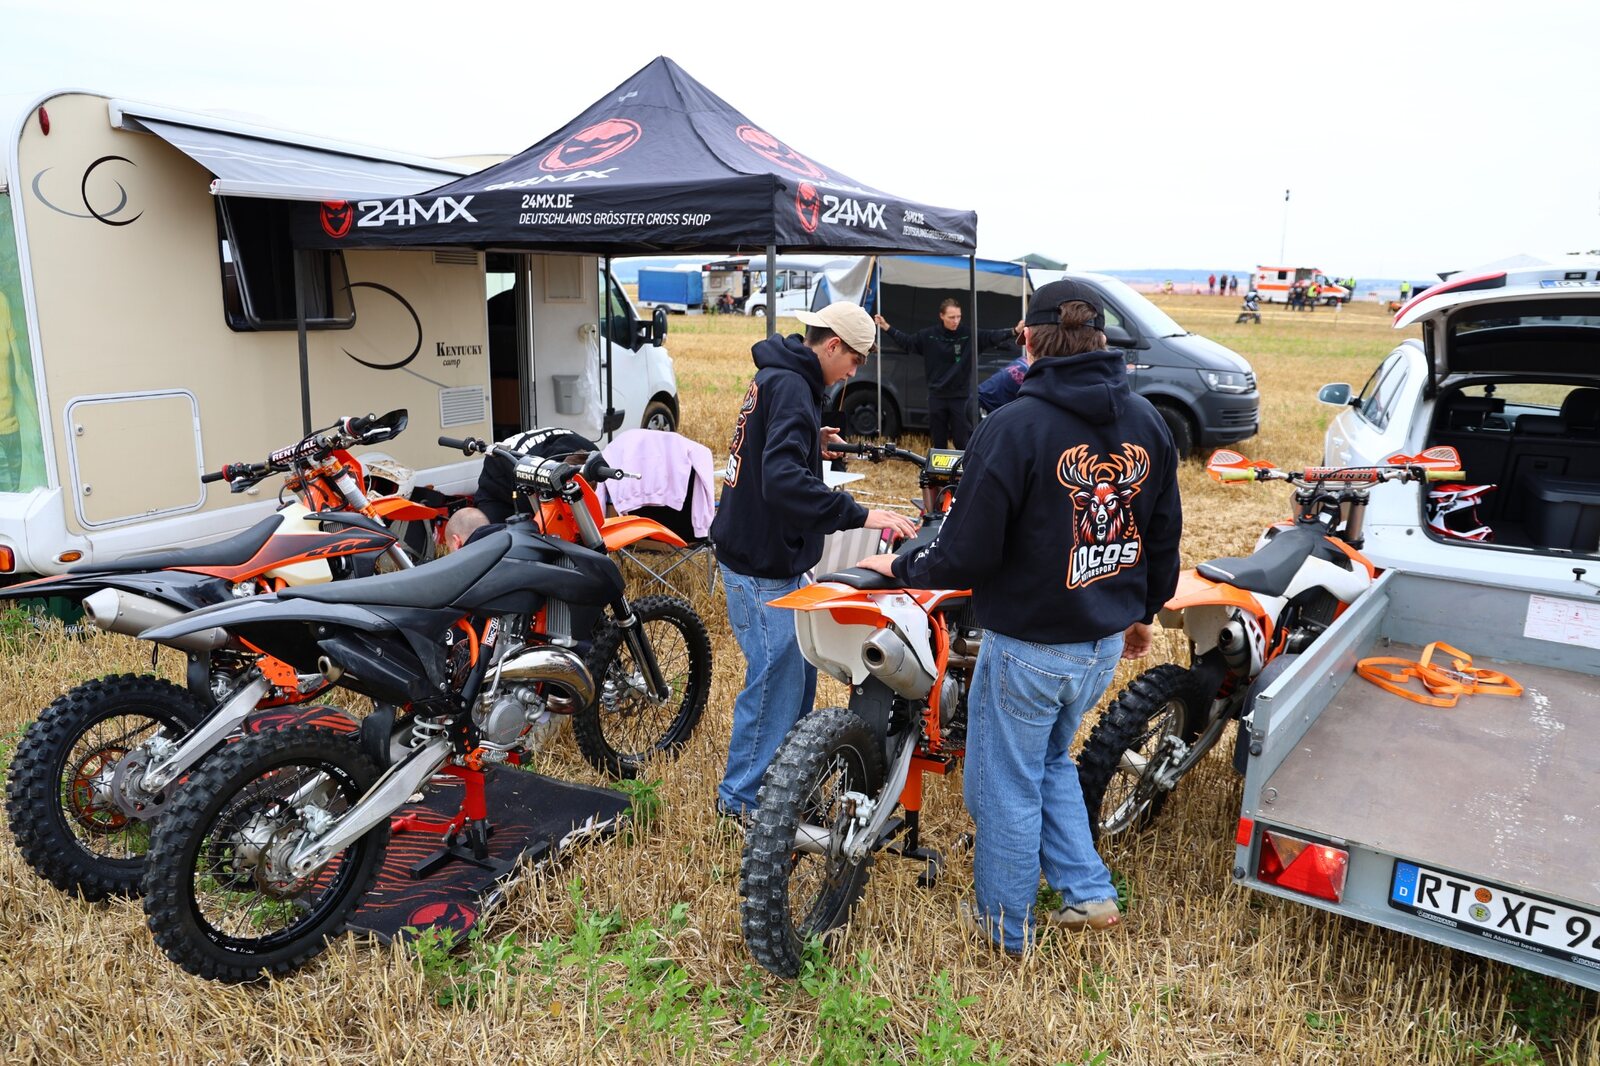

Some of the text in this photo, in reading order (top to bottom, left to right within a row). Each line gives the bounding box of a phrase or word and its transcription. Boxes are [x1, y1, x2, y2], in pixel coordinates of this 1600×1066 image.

[357, 195, 479, 228] 24MX
[521, 194, 574, 210] 24MX.DE
[519, 210, 711, 227] DEUTSCHLANDS GRÖSSTER CROSS SHOP
[821, 195, 888, 231] 24MX
[443, 359, 461, 368] camp
[1071, 541, 1139, 585] LOCOS
[1080, 563, 1117, 582] MOTORSPORT
[1399, 886, 1408, 897] D
[1416, 873, 1471, 914] RT
[1497, 896, 1556, 937] XF
[1481, 931, 1543, 953] Mit Abstand besser
